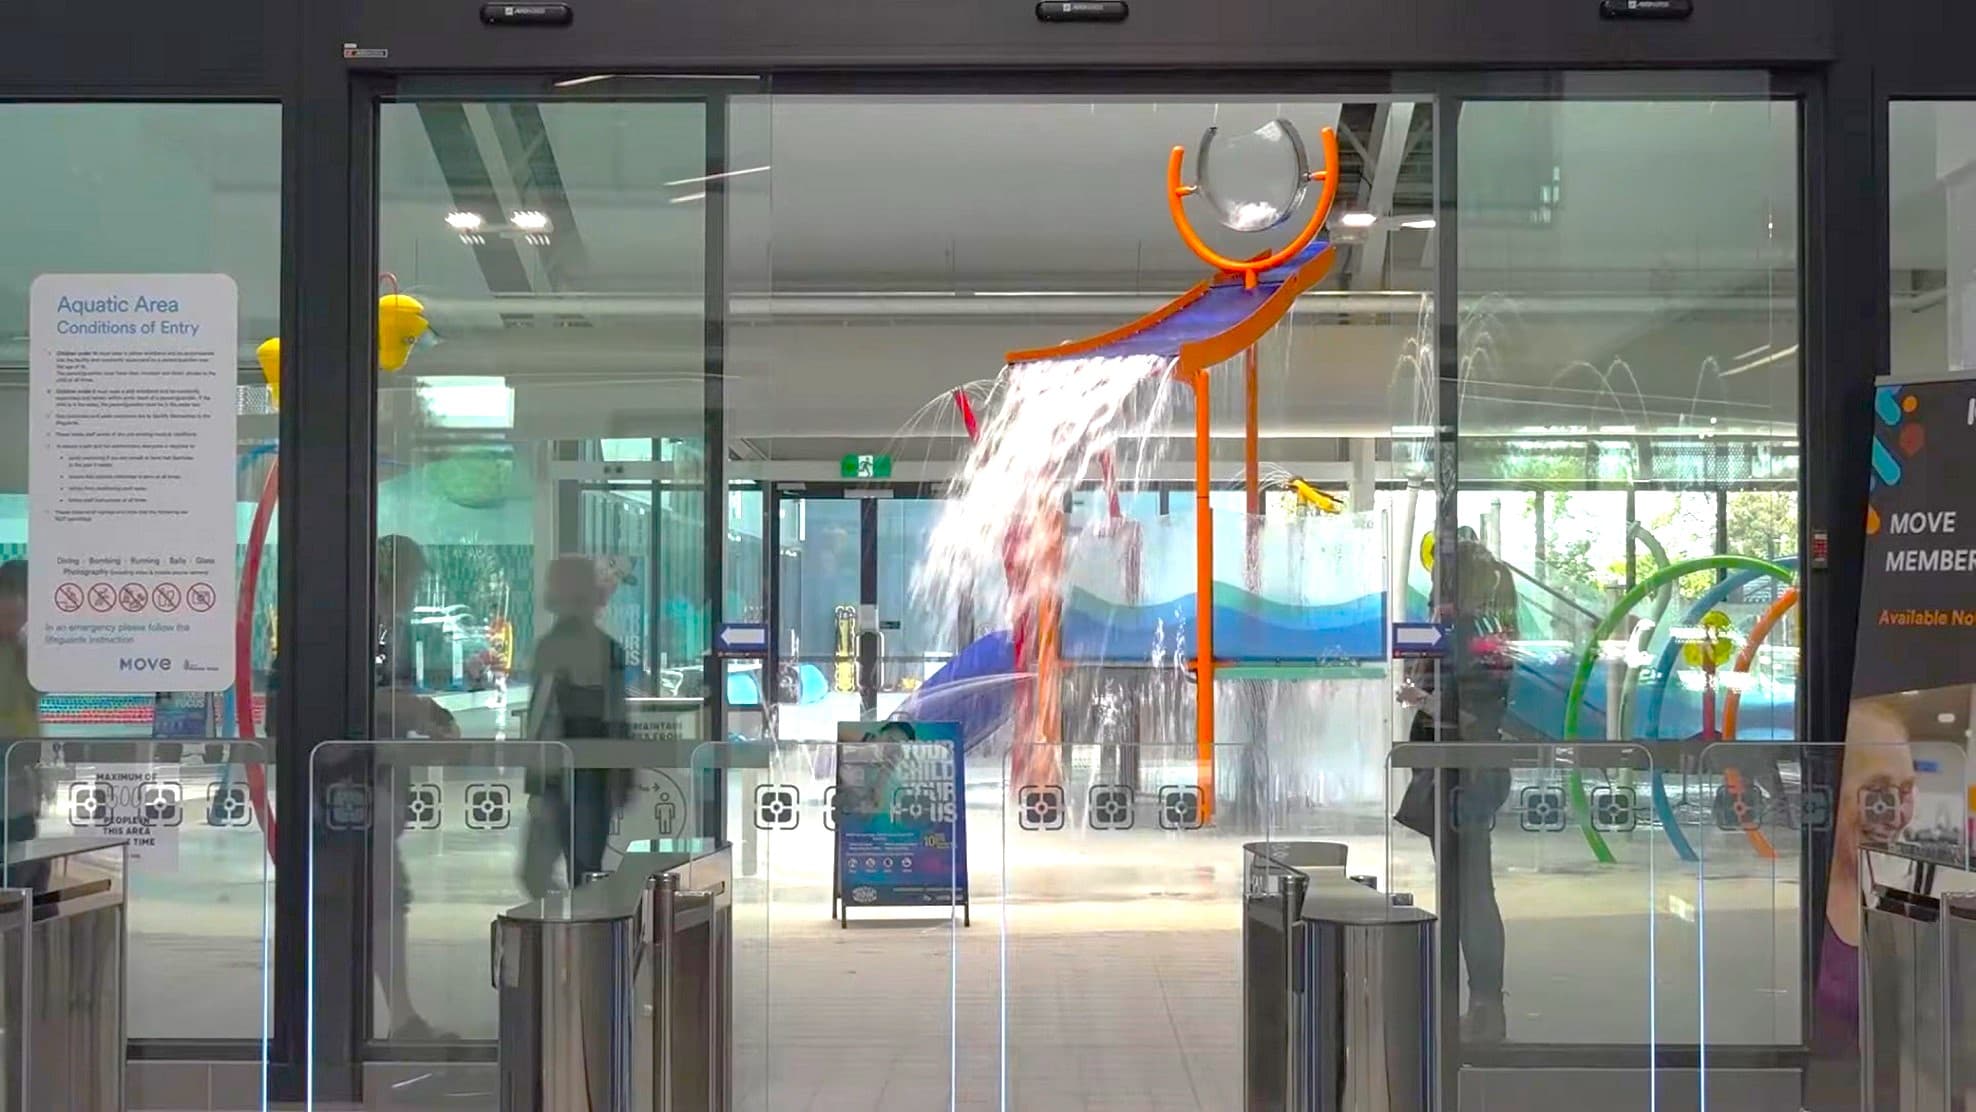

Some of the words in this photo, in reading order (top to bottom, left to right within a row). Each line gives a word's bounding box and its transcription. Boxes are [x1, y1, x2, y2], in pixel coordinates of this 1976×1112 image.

[57, 296, 129, 315] Aquatic
[134, 296, 179, 313] Area
[57, 320, 137, 334] Conditions
[141, 320, 155, 334] of
[161, 321, 199, 336] Entry
[1890, 511, 1956, 534] MOVE
[89, 556, 121, 566] Bombing
[130, 556, 160, 566] Running
[63, 568, 108, 577] Photography
[1878, 609, 1948, 626] Available
[1951, 610, 1976, 625] No
[69, 624, 116, 633] emergency
[118, 622, 146, 633] please
[148, 622, 174, 631] follow
[176, 622, 190, 632] the
[895, 760, 956, 780] CHILD
[96, 773, 142, 781] MAXIMUM
[144, 773, 158, 781] OF
[103, 816, 138, 825] PEOPLE
[103, 827, 124, 835] THIS
[125, 827, 151, 835] AREA
[133, 838, 156, 846] TIME
